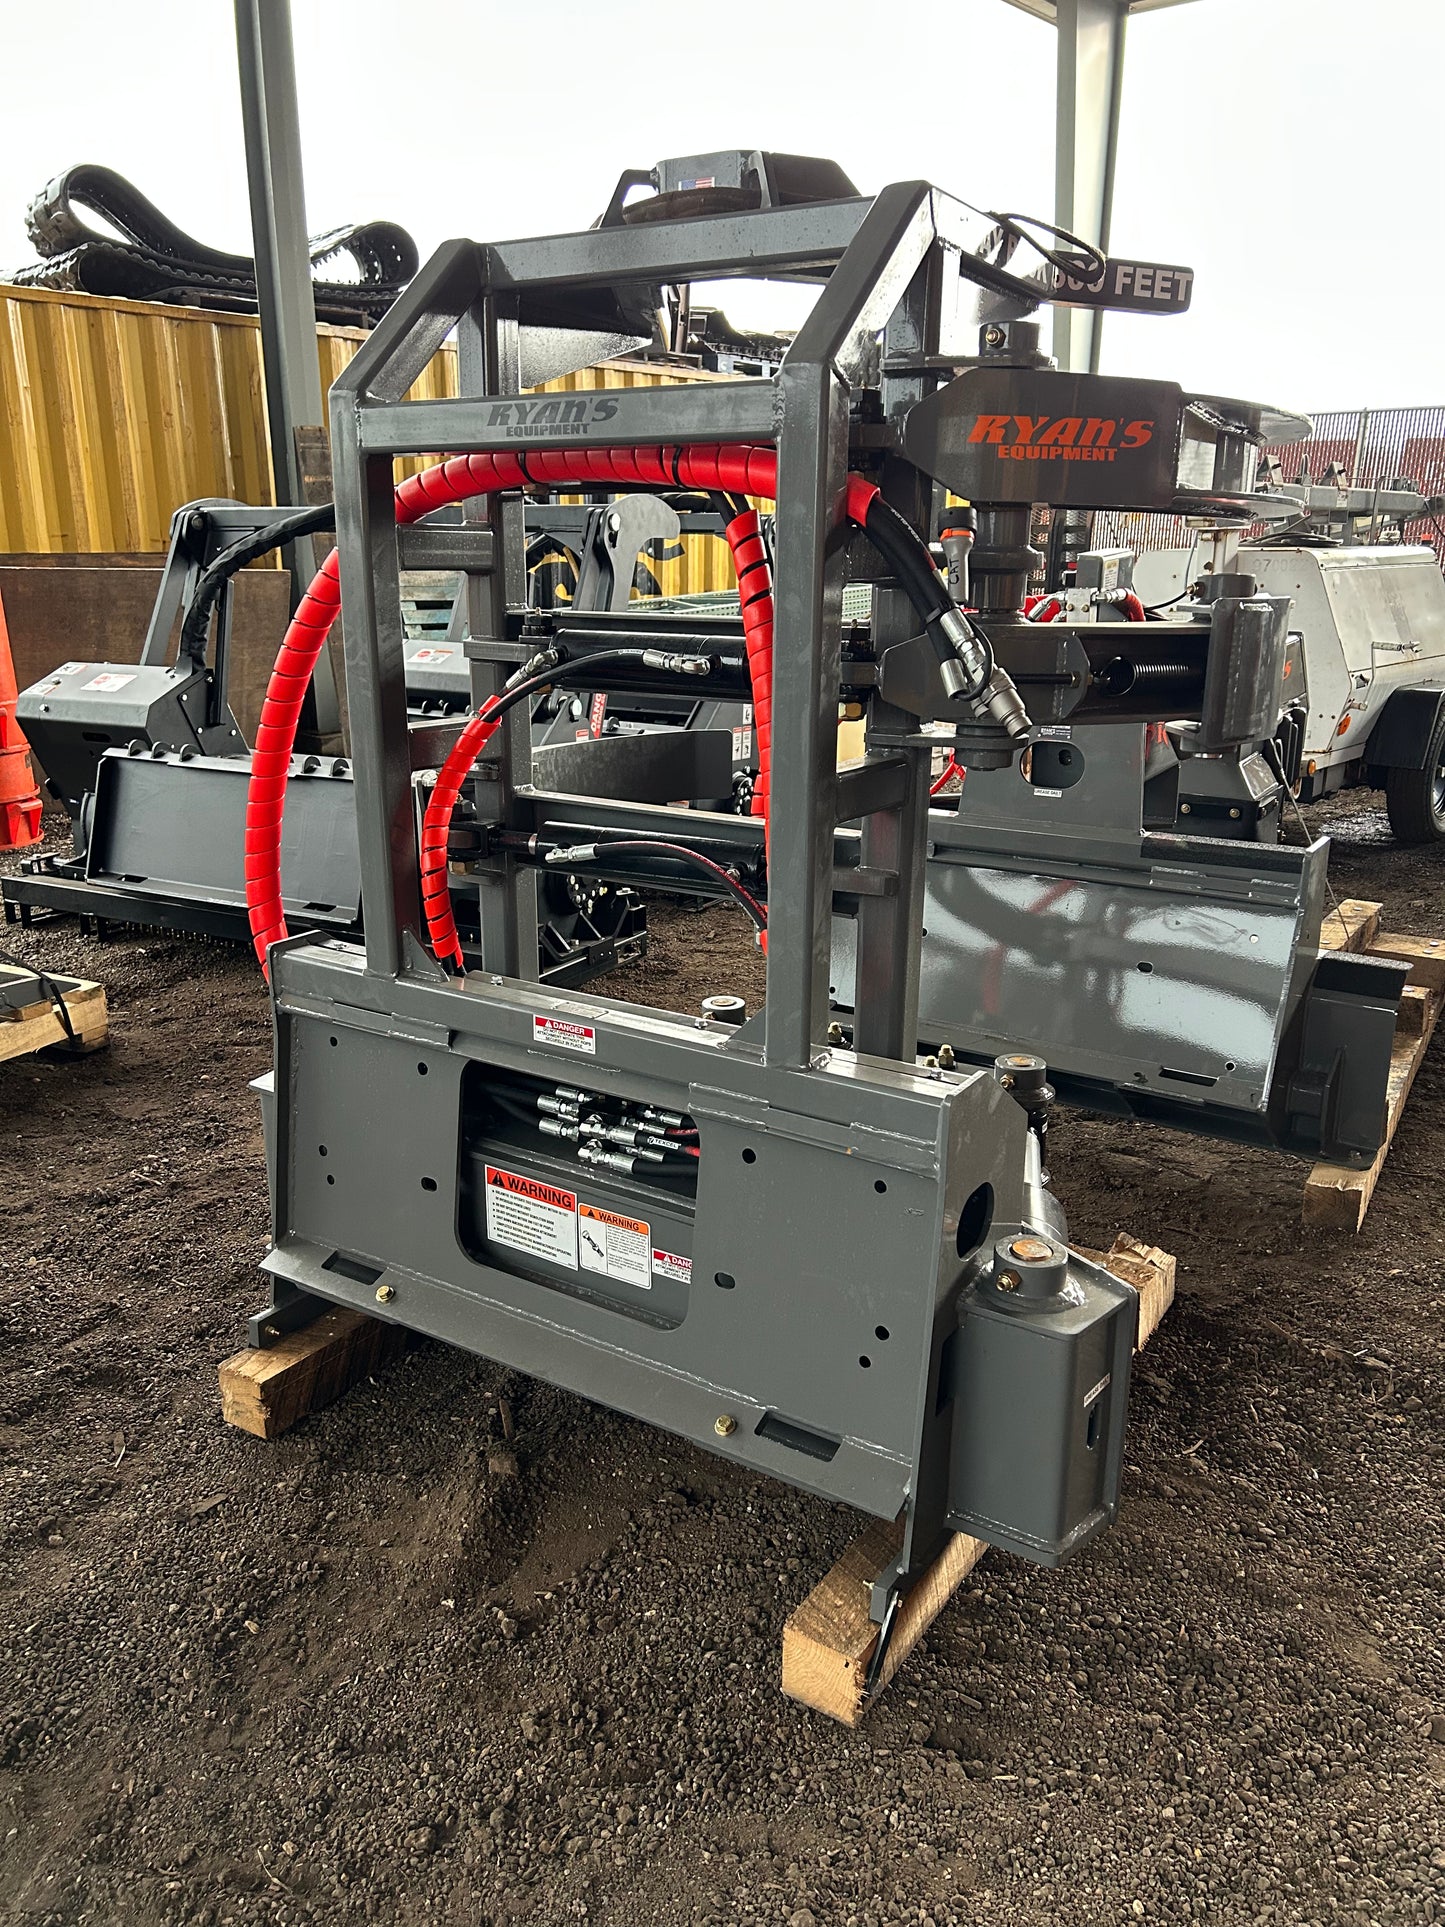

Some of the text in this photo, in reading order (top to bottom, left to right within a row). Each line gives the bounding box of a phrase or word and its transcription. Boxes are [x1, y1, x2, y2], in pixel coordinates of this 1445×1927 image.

[1115, 265, 1194, 302] FEET
[487, 398, 620, 426] RYAN'S
[506, 423, 591, 437] EQUIPMENT
[967, 415, 1155, 448] RYAN'S
[998, 445, 1118, 461] EQUIPMENT
[949, 558, 960, 585] CAT
[553, 1022, 584, 1035] DANGER
[655, 1138, 679, 1149] TEXCEL
[508, 1176, 571, 1207] WARNING
[599, 1212, 639, 1231] WARNING
